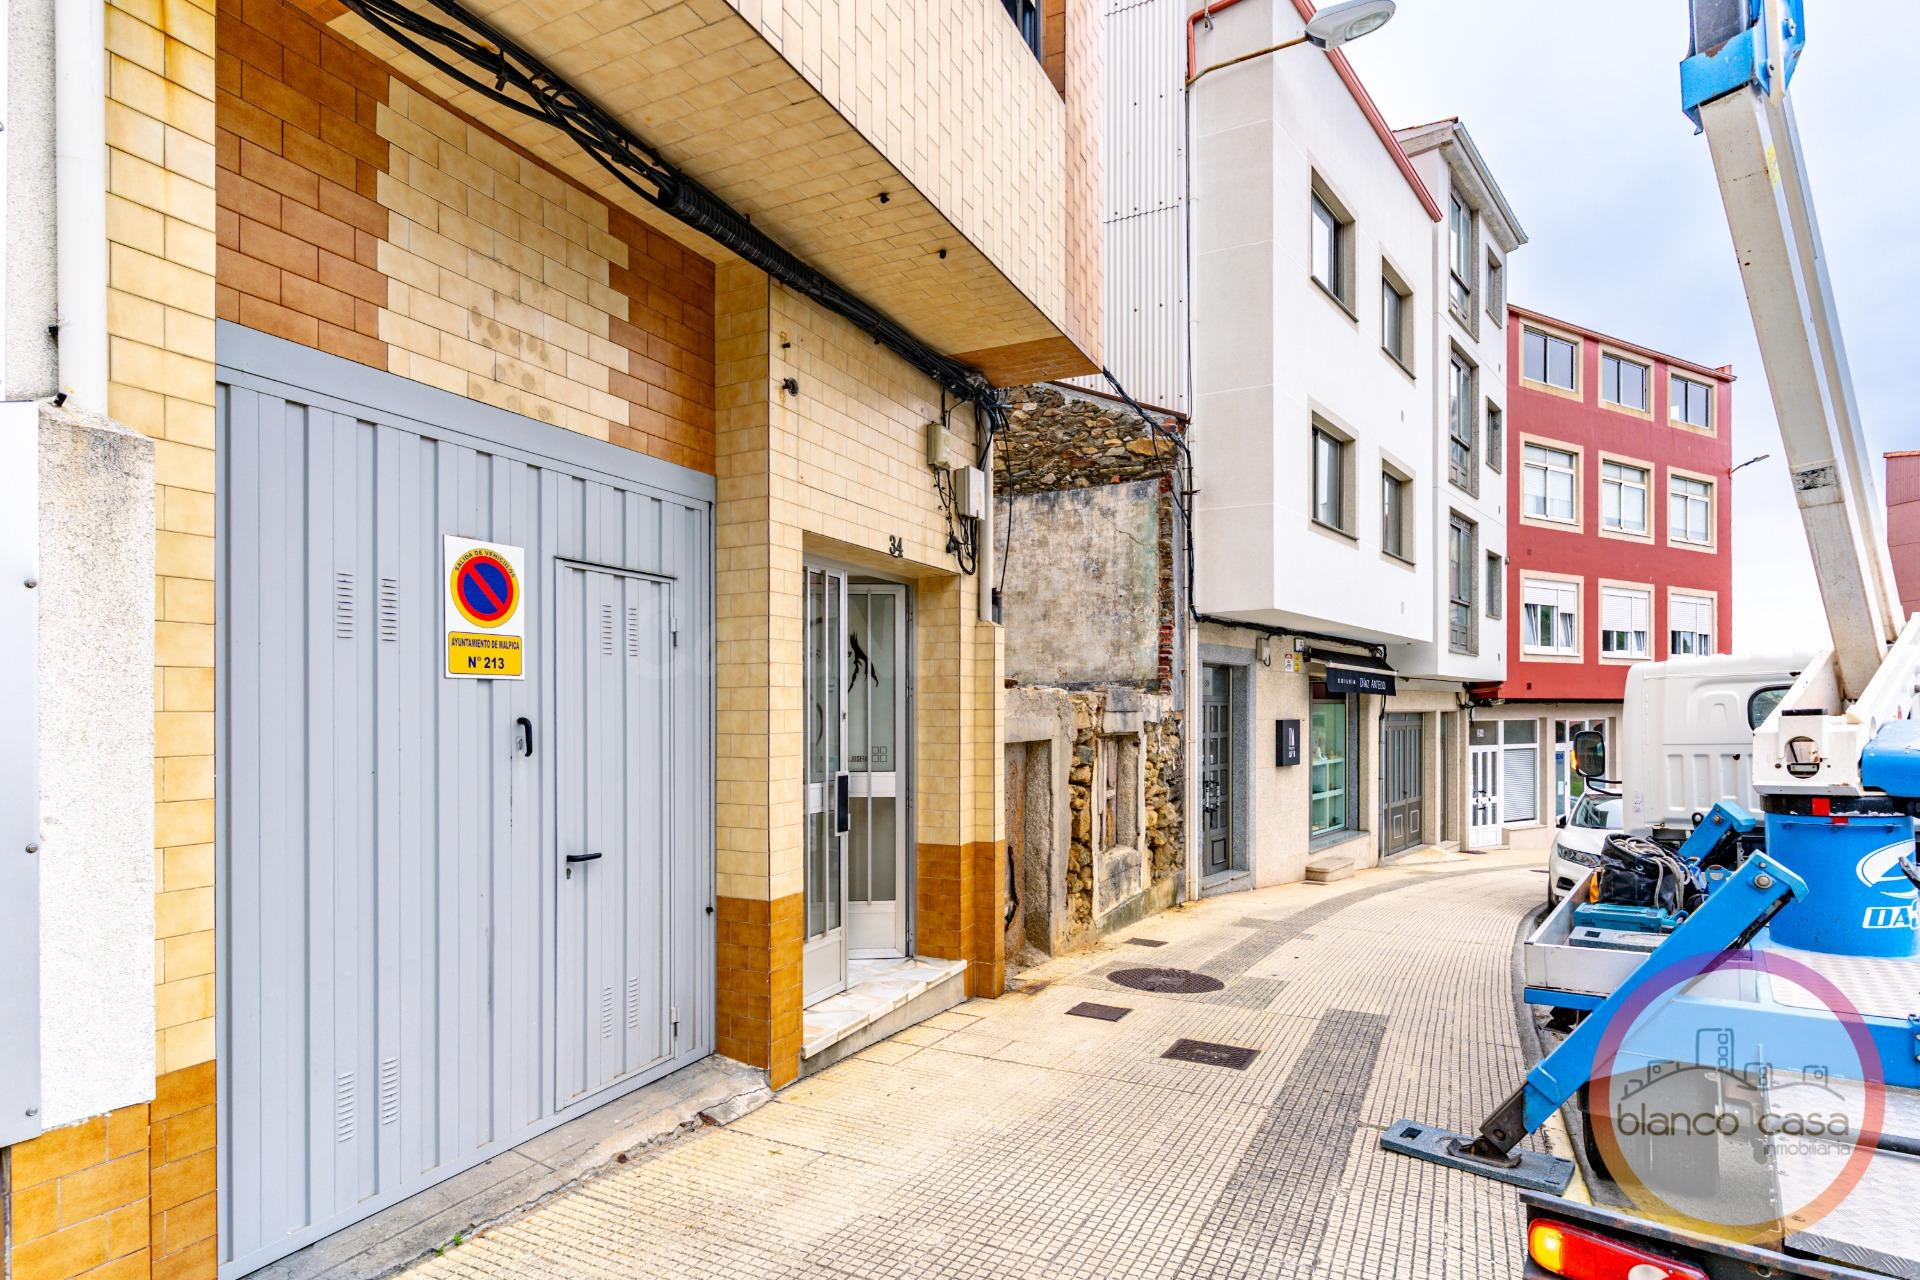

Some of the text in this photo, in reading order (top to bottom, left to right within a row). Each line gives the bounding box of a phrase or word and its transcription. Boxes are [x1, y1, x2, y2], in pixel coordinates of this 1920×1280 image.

[889, 535, 904, 558] 34
[454, 552, 473, 572] SALIDA
[484, 550, 516, 578] VEHICULOS
[451, 637, 520, 650] AYUNTAMIENTO DE MALPICA
[484, 656, 505, 670] 213
